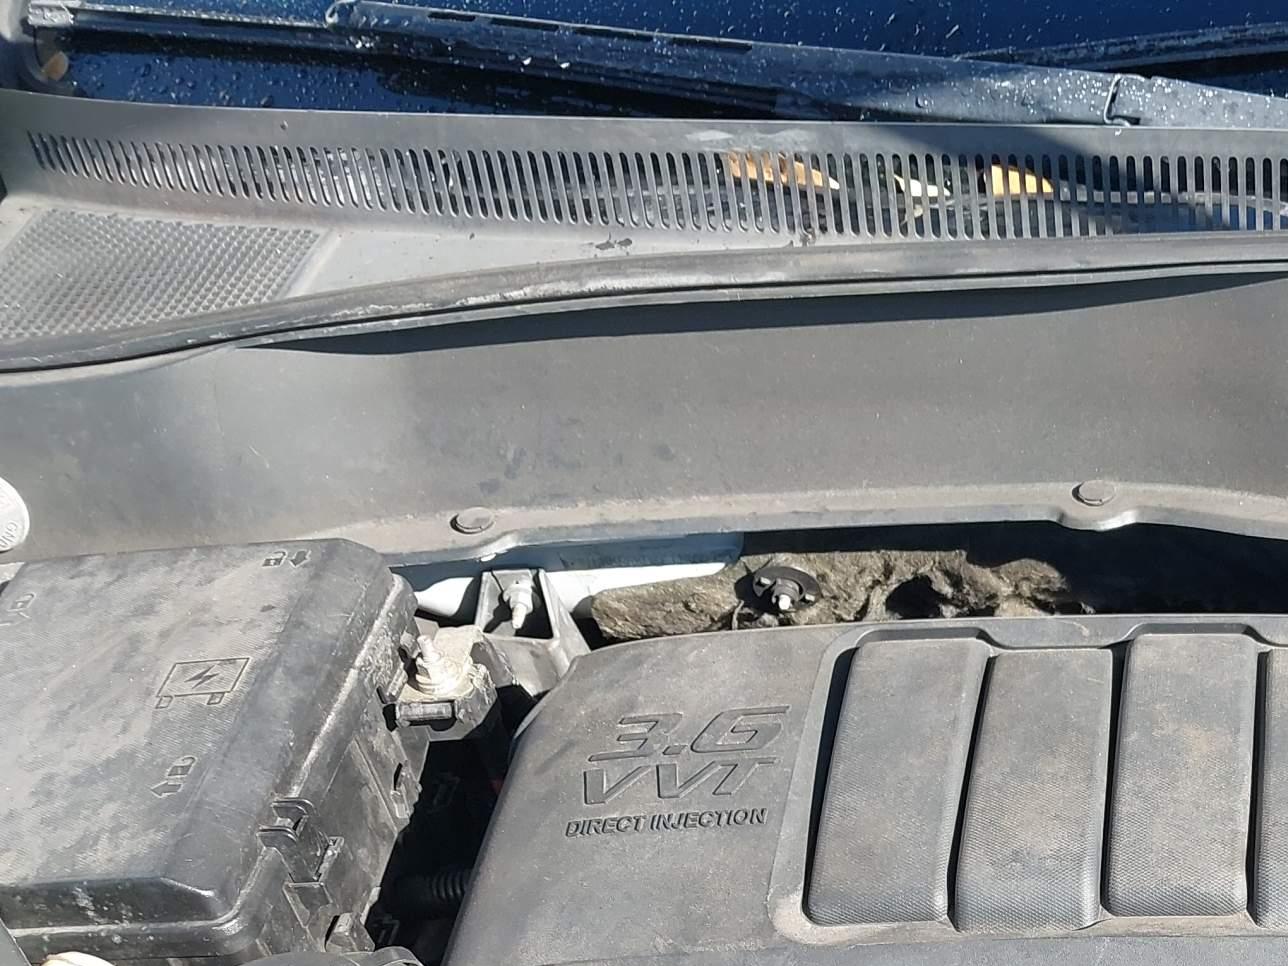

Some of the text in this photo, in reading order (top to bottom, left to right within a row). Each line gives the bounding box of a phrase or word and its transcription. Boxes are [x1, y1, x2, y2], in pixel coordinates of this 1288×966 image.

[589, 705, 790, 761] 3.6
[584, 757, 783, 805] VVT
[564, 808, 768, 838] DIRECT INJECTION
